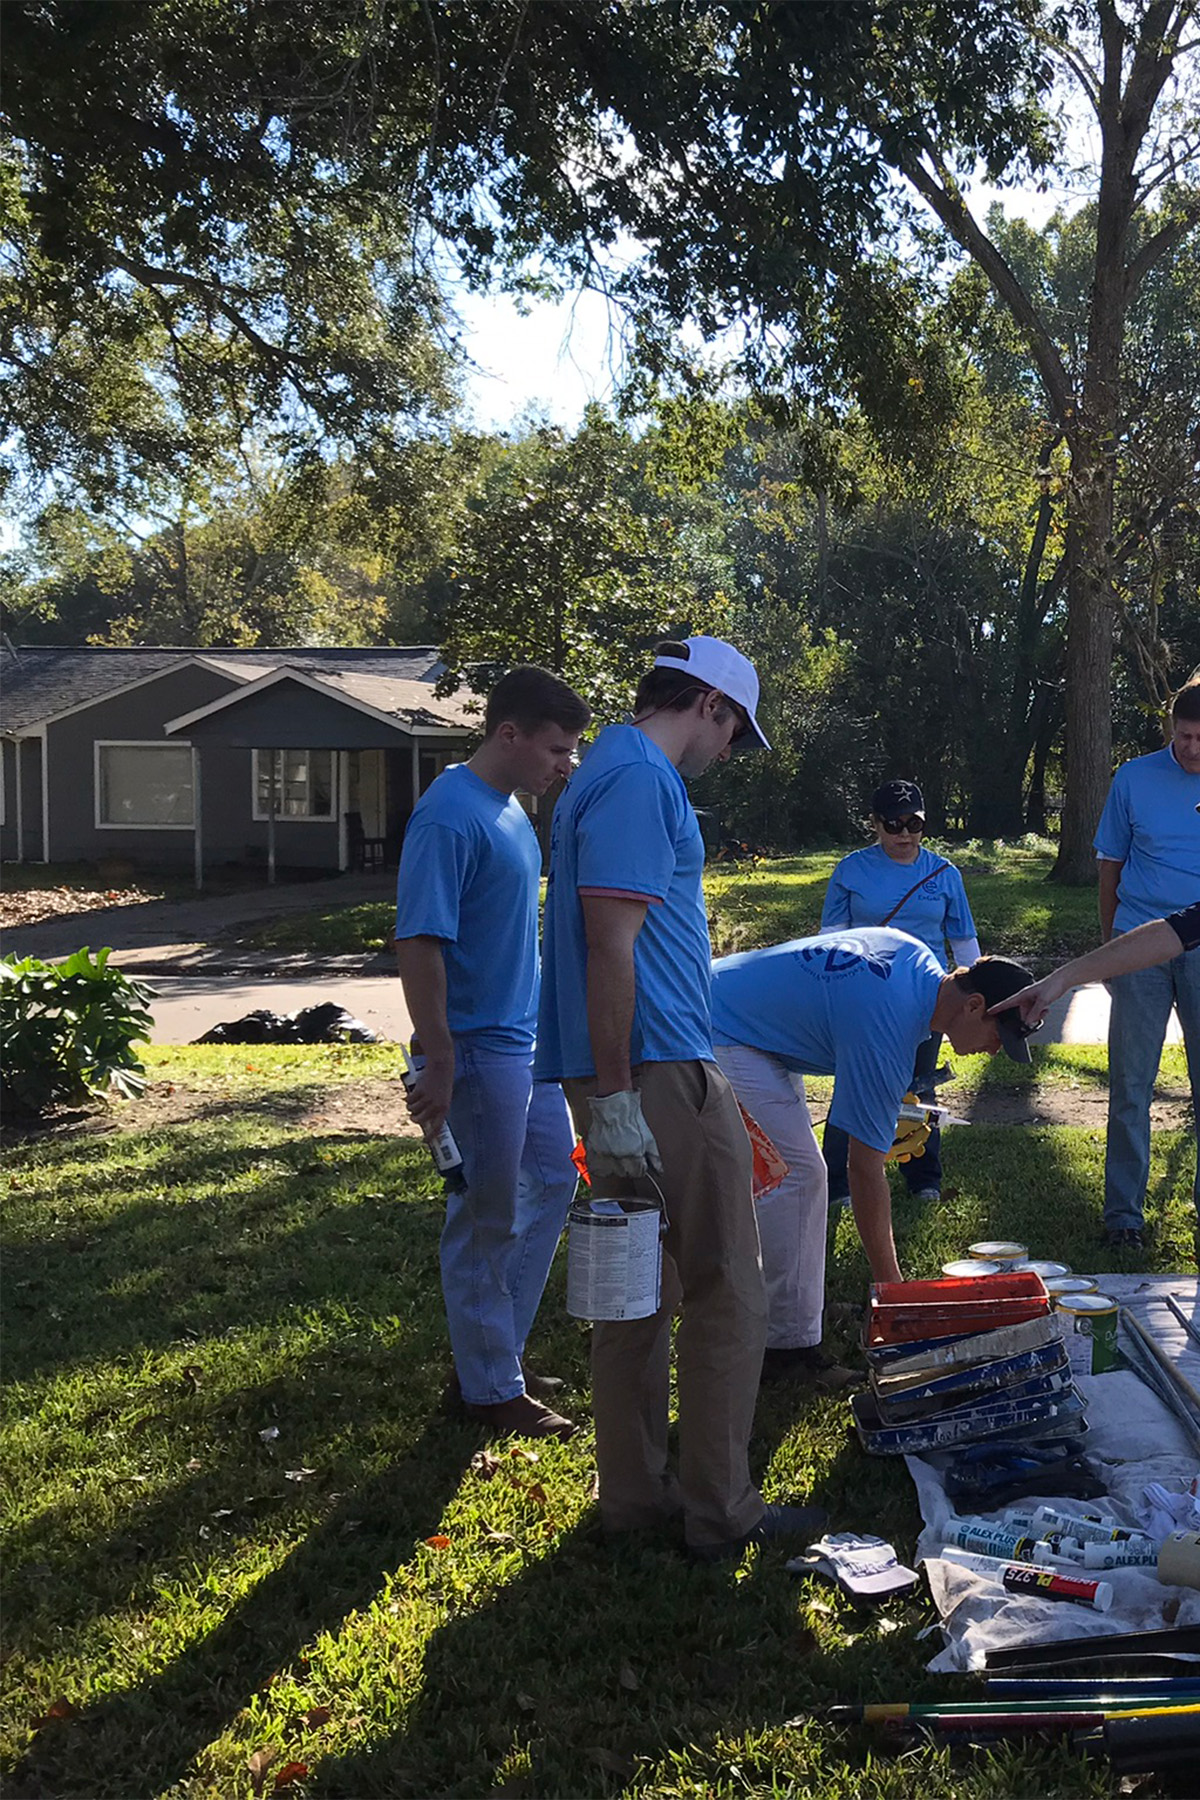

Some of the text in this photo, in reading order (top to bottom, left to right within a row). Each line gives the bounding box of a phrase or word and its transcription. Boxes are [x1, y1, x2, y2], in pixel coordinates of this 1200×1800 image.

[969, 1527, 1019, 1546] ALEX PLUS
[1115, 1555, 1141, 1566] ALEX
[1005, 1568, 1034, 1584] 375
[1036, 1573, 1055, 1588] PL
